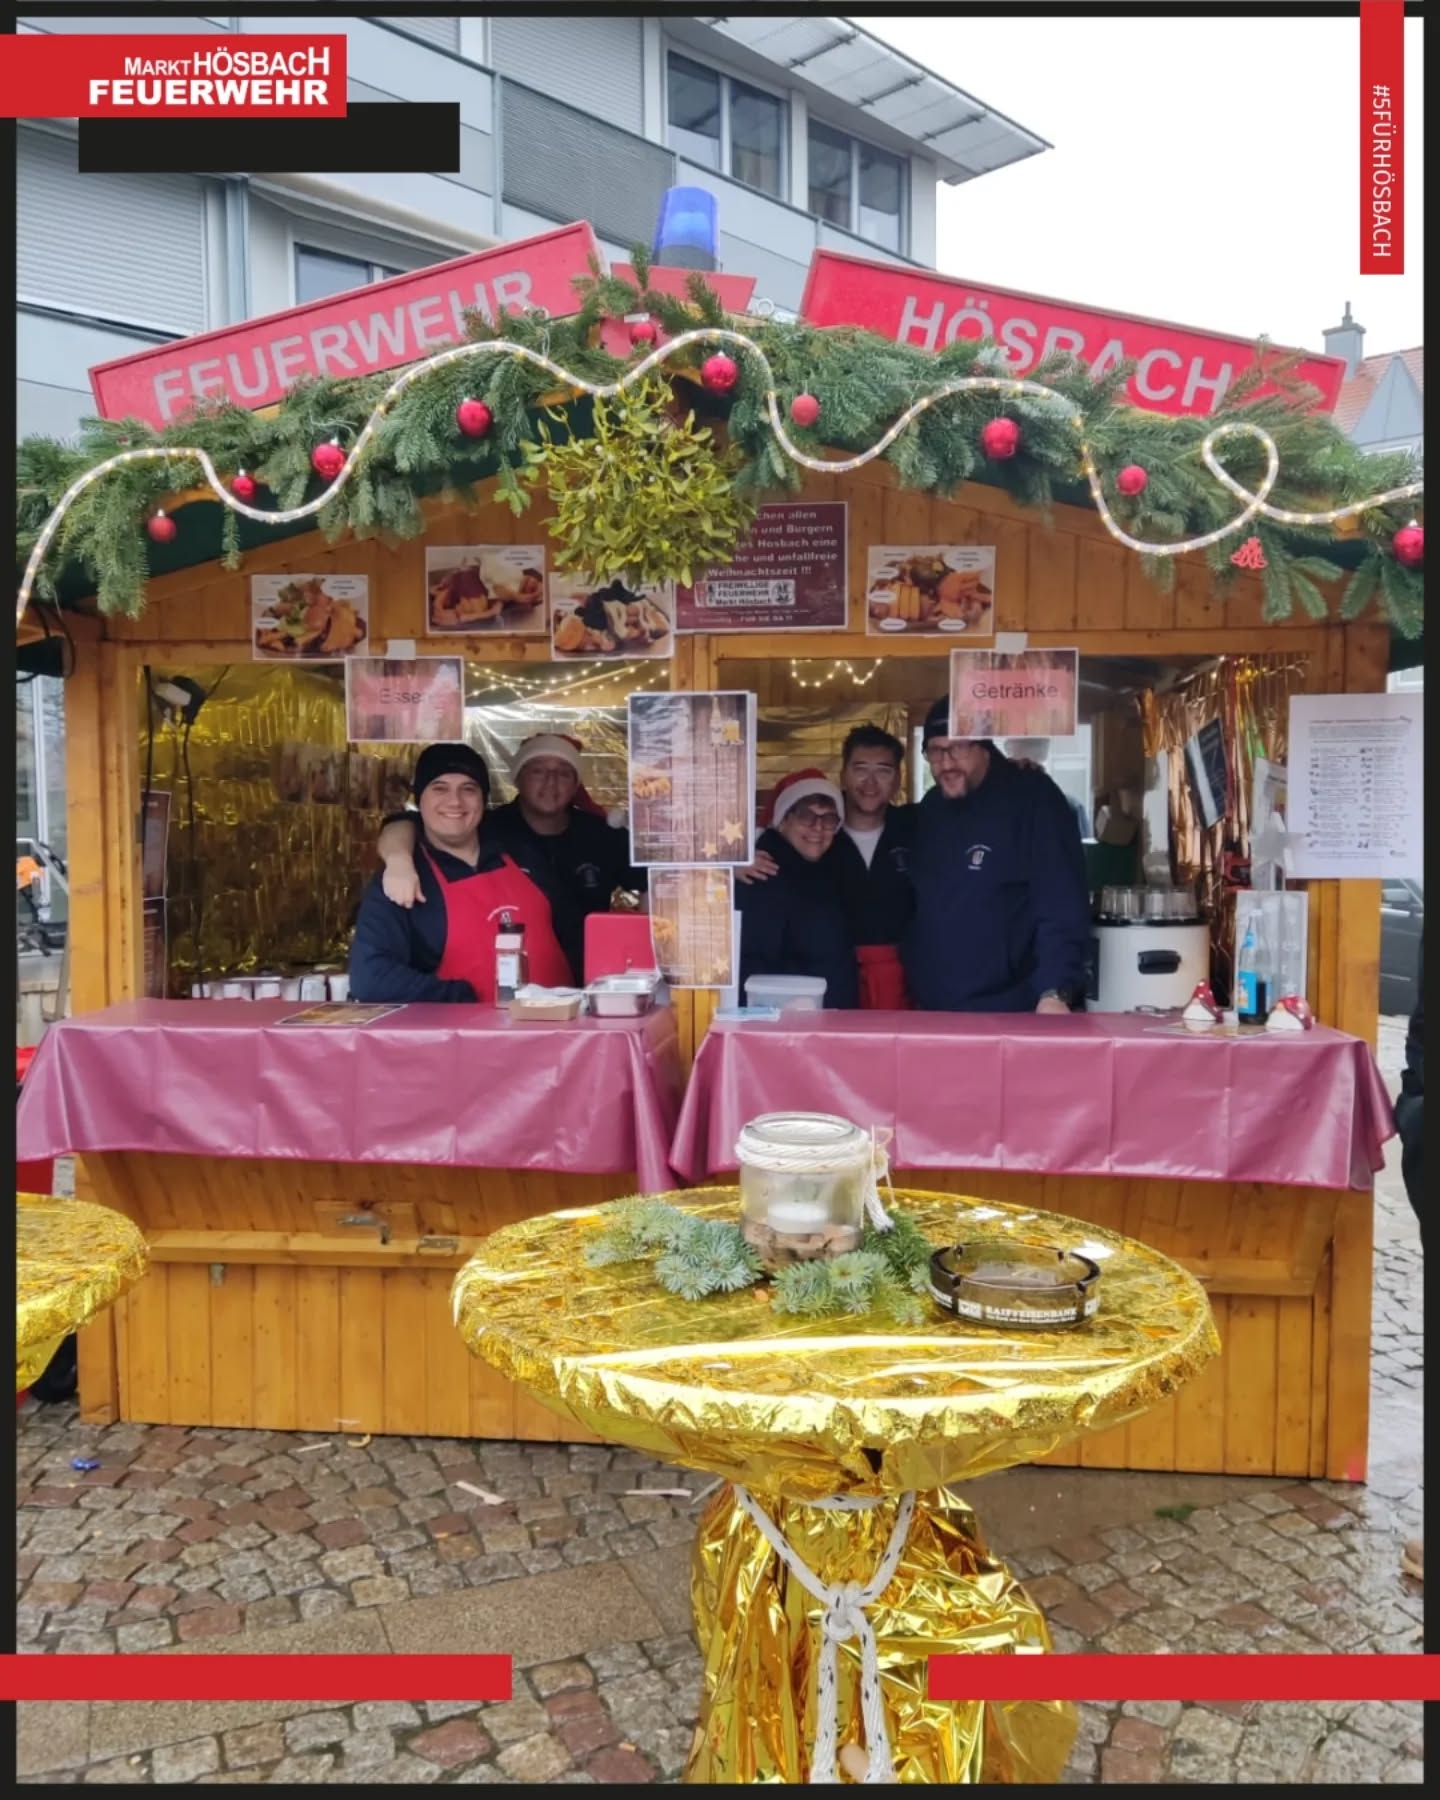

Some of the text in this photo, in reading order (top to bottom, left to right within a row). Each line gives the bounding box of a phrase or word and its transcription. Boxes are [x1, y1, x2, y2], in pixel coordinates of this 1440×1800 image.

[152, 270, 534, 421] FEUERWEHR
[788, 510, 817, 520] allen
[760, 525, 783, 534] und
[811, 538, 838, 547] eine
[752, 553, 775, 562] und
[778, 551, 838, 561] unfallfreie
[708, 566, 797, 577] Weihnachtszeit
[379, 687, 431, 704] Esse
[971, 682, 1059, 699] Getränke
